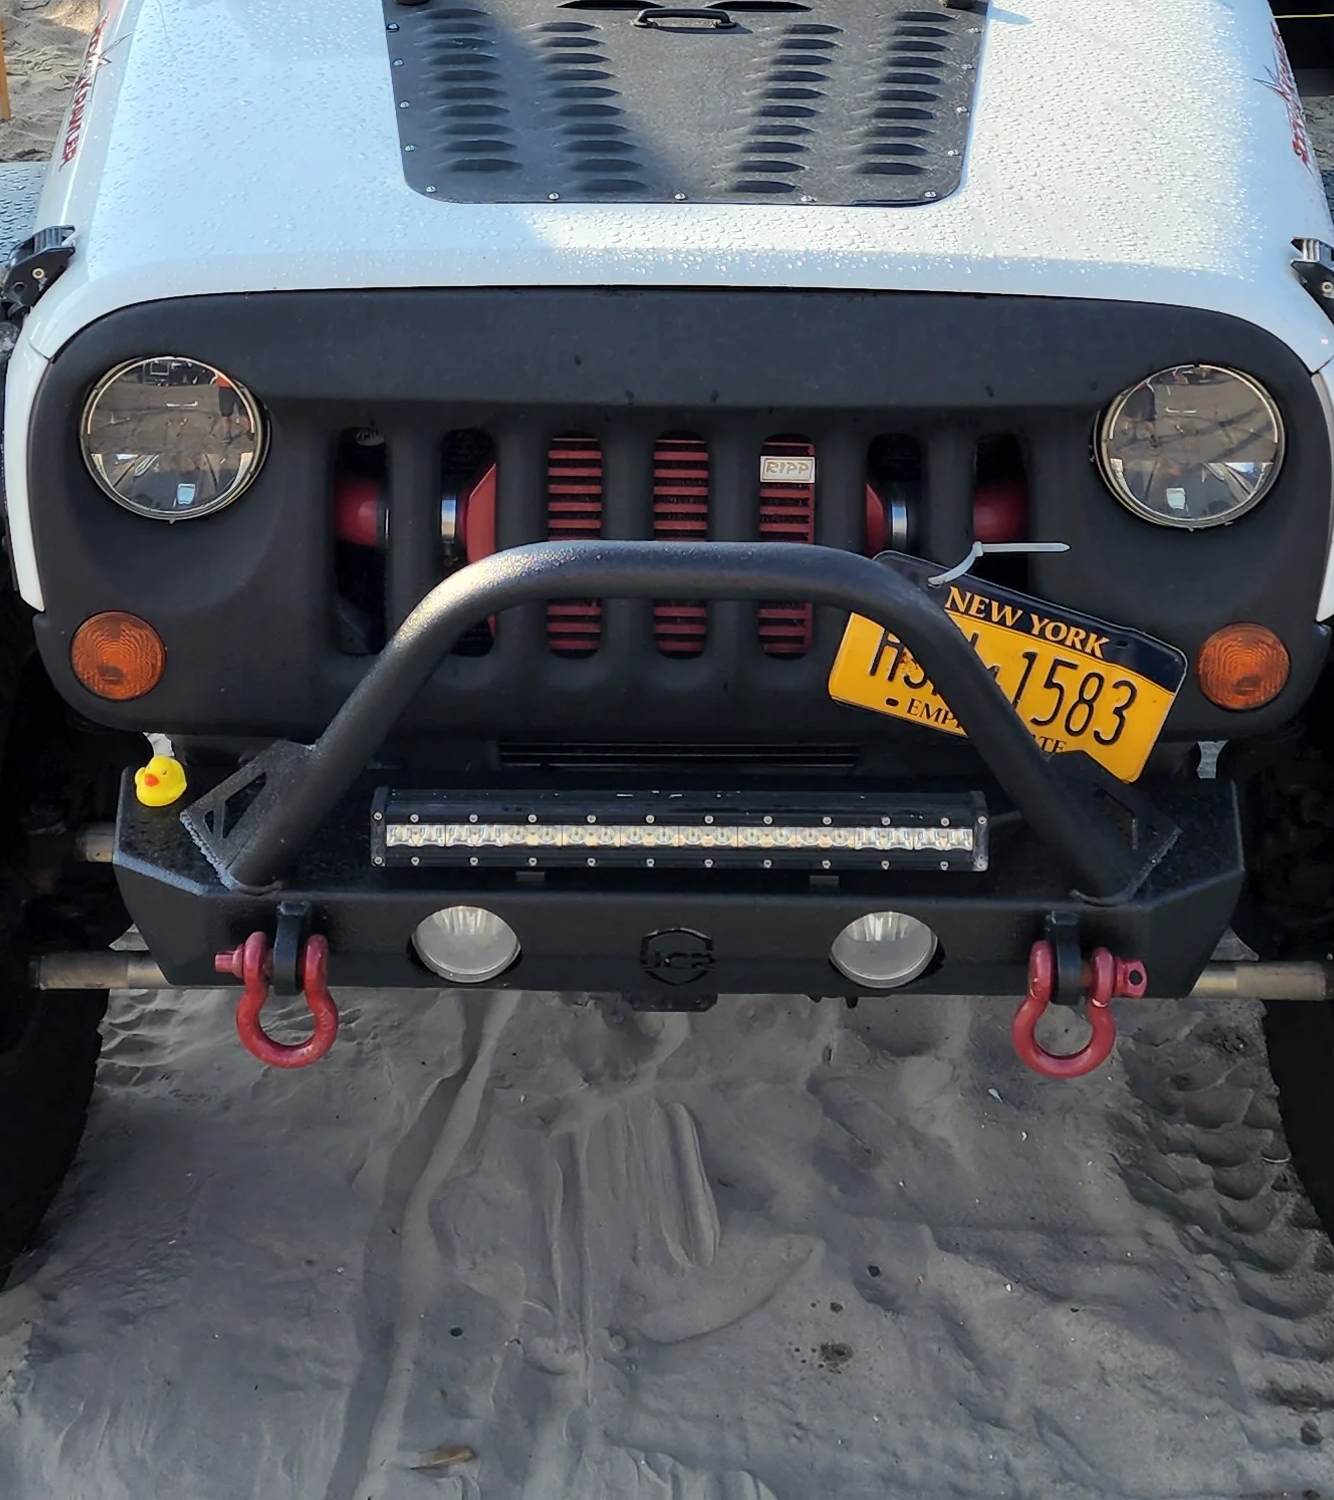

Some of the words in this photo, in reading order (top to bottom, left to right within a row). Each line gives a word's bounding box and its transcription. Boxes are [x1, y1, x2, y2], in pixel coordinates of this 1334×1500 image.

[766, 461, 809, 475] RIPP
[944, 585, 1023, 628] NEW
[1029, 612, 1110, 660] YORK
[905, 696, 965, 730] EMP
[1010, 649, 1139, 747] 1583
